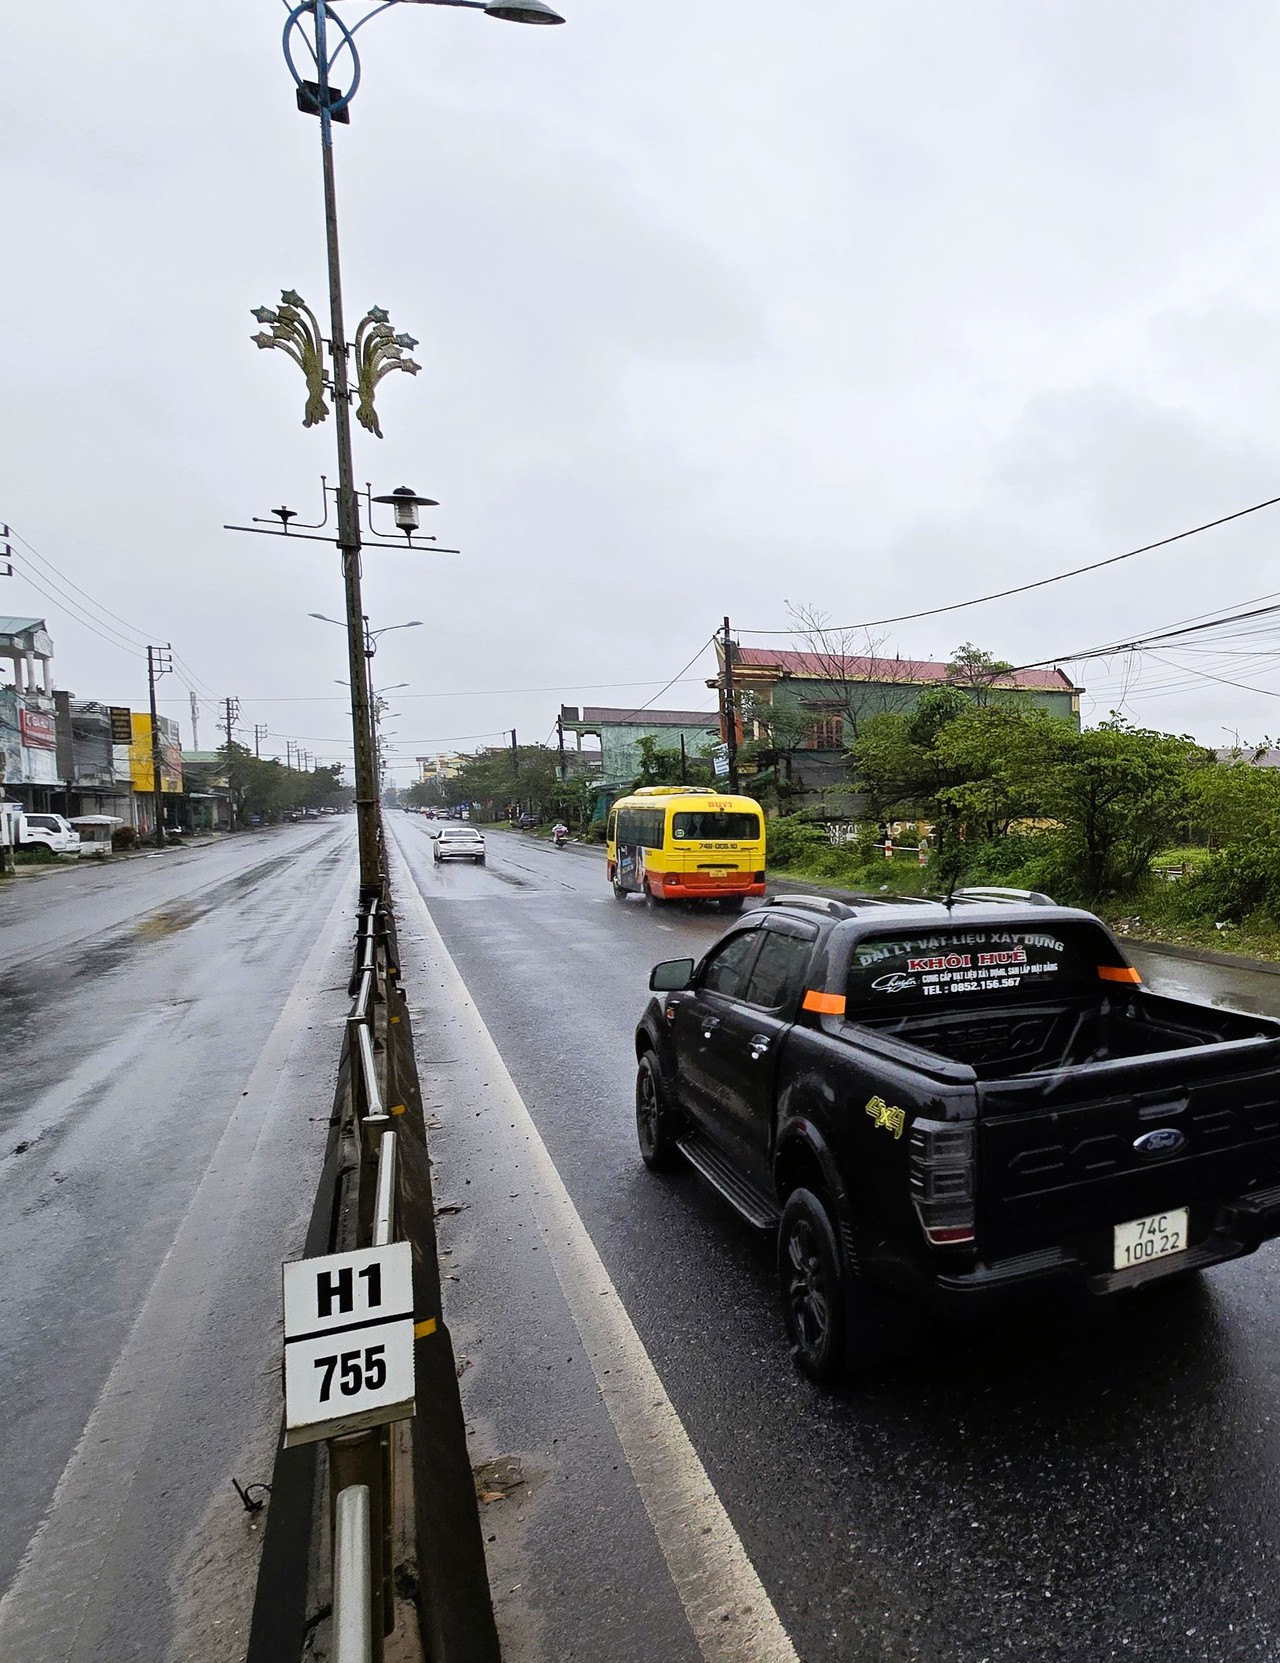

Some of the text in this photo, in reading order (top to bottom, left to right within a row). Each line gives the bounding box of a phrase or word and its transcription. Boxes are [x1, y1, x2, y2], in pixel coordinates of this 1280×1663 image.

[906, 952, 972, 972] KHÔI
[922, 985, 943, 995] TEL
[950, 977, 1021, 993] 0852.156.567
[1147, 1132, 1176, 1150] Ford
[1137, 1216, 1168, 1240] 74C
[1125, 1232, 1180, 1263] 100.22
[316, 1262, 382, 1319] H1
[313, 1344, 387, 1403] 755
